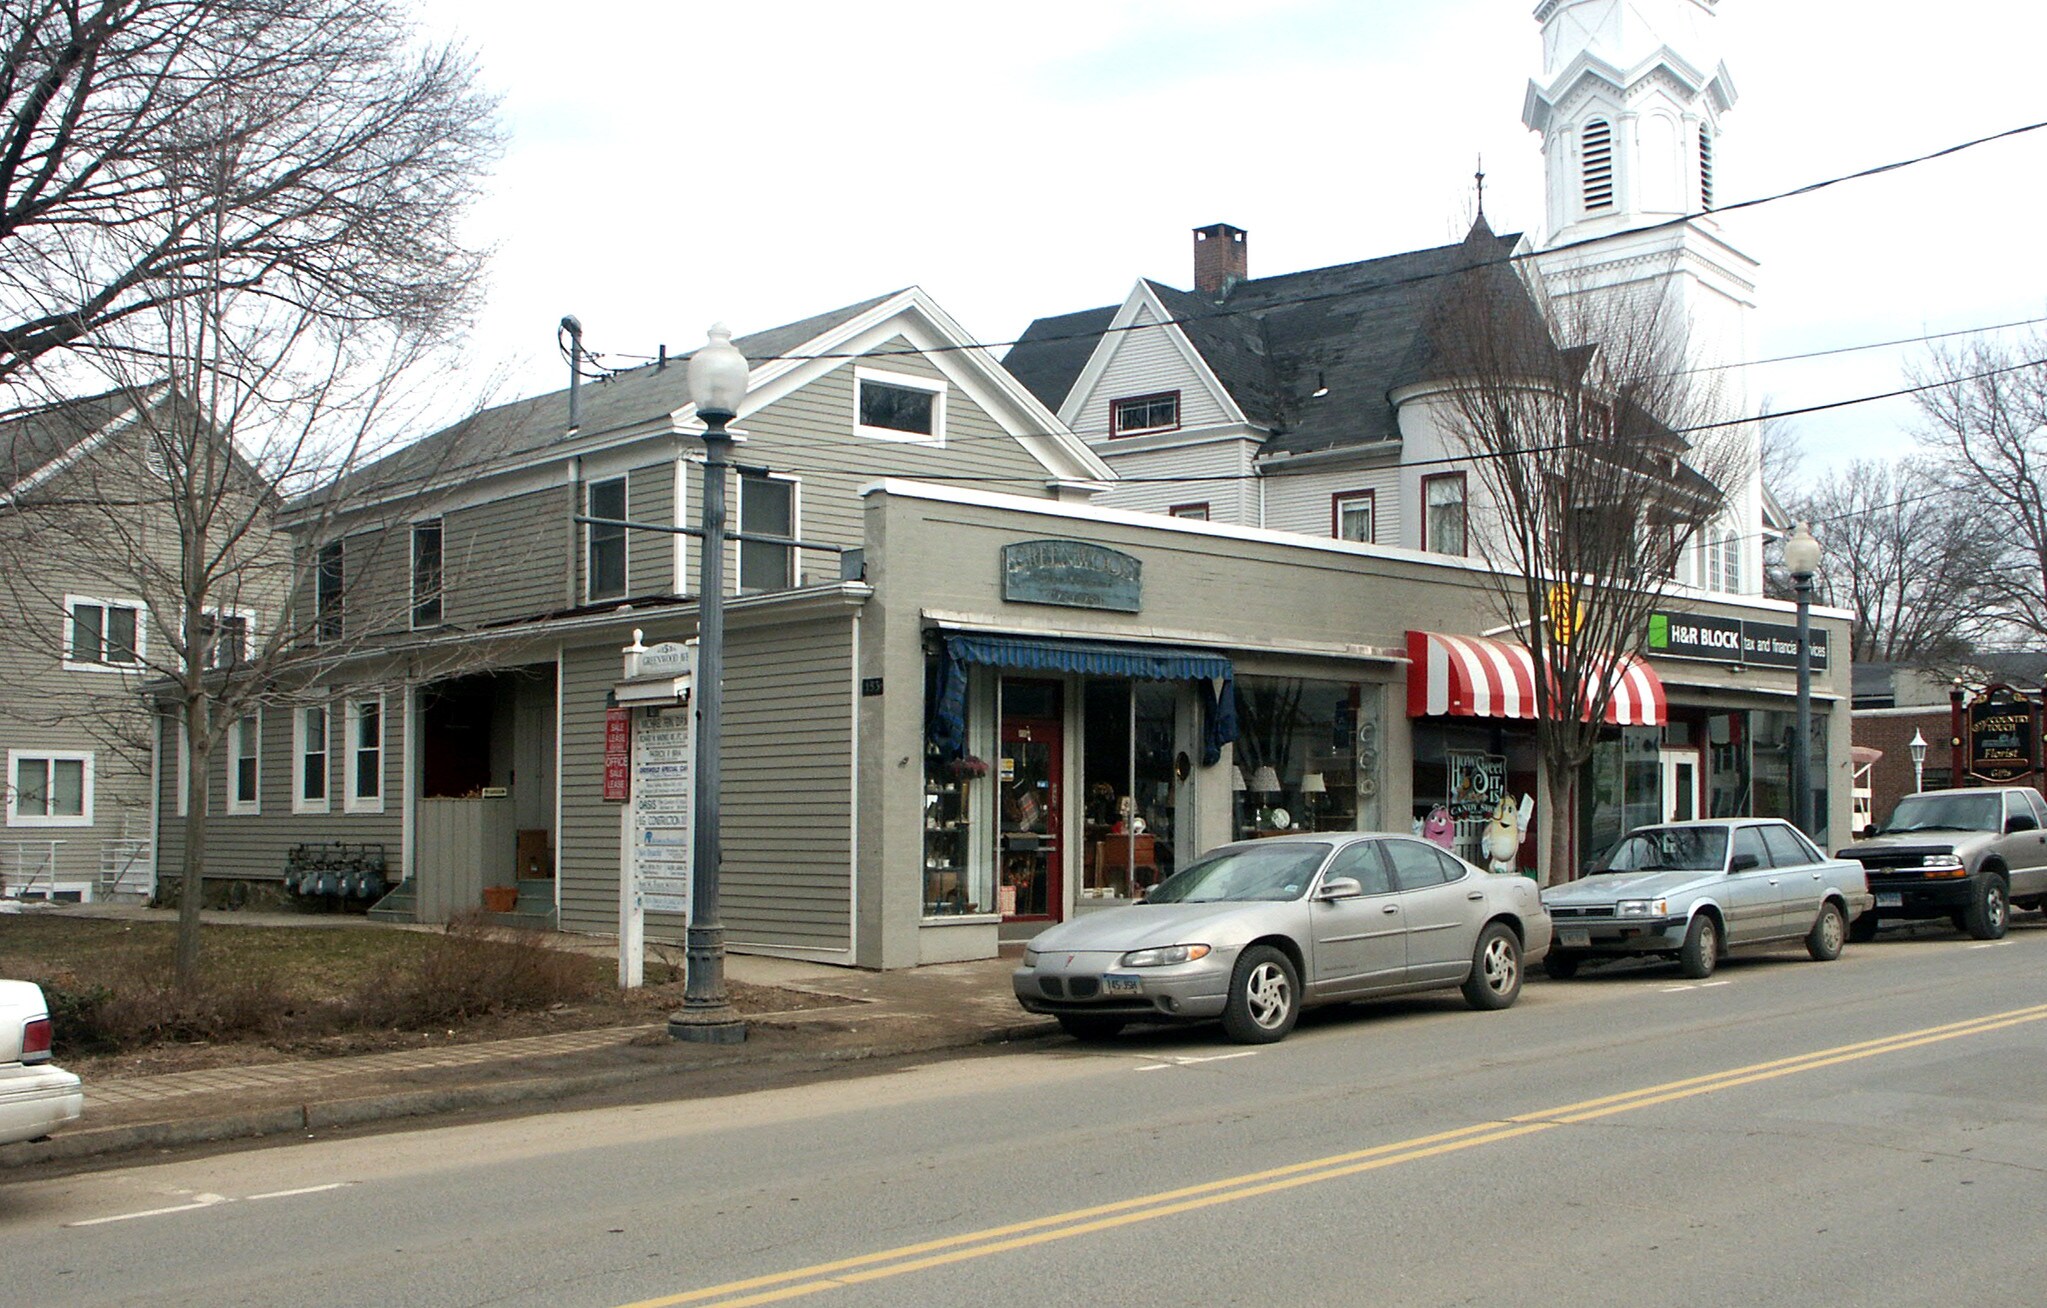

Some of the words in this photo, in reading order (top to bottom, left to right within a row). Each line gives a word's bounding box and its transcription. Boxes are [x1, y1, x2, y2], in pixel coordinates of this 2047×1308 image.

[1672, 625, 1698, 645] H&R
[1700, 628, 1739, 649] BLOCK
[1744, 637, 1755, 651] tax
[1757, 639, 1770, 653] and
[1772, 638, 1797, 655] financia
[1809, 643, 1826, 657] vices
[643, 654, 679, 665] GREENWOOD
[1987, 715, 2028, 723] COUNTRY
[611, 723, 624, 732] SALE
[608, 734, 625, 743] LEASE
[1985, 748, 2018, 758] Florist
[606, 757, 628, 767] OFFICE
[609, 769, 623, 778] SALE
[607, 780, 624, 789] LEASE
[1489, 776, 1500, 789] IT
[639, 800, 656, 810] OASIS
[1450, 803, 1477, 815] CANDY
